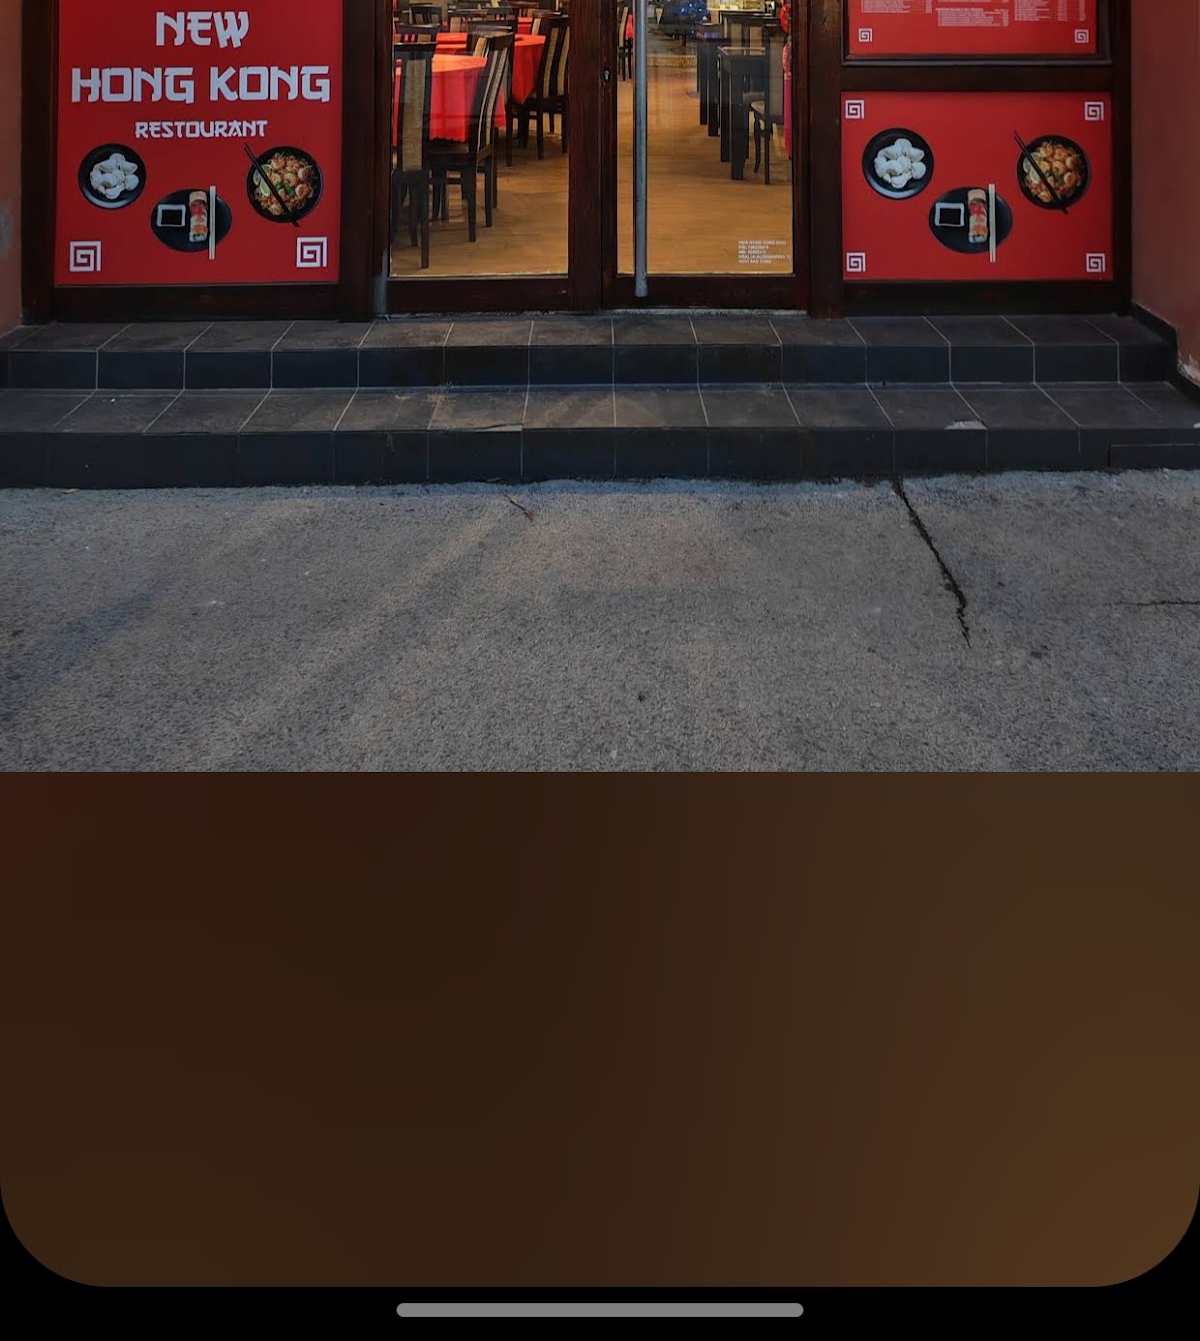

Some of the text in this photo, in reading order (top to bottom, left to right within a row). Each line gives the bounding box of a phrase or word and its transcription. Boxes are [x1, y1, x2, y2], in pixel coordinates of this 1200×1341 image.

[155, 11, 250, 49] NEW
[71, 65, 331, 104] HONG KONG
[134, 120, 268, 139] RESTOURANT
